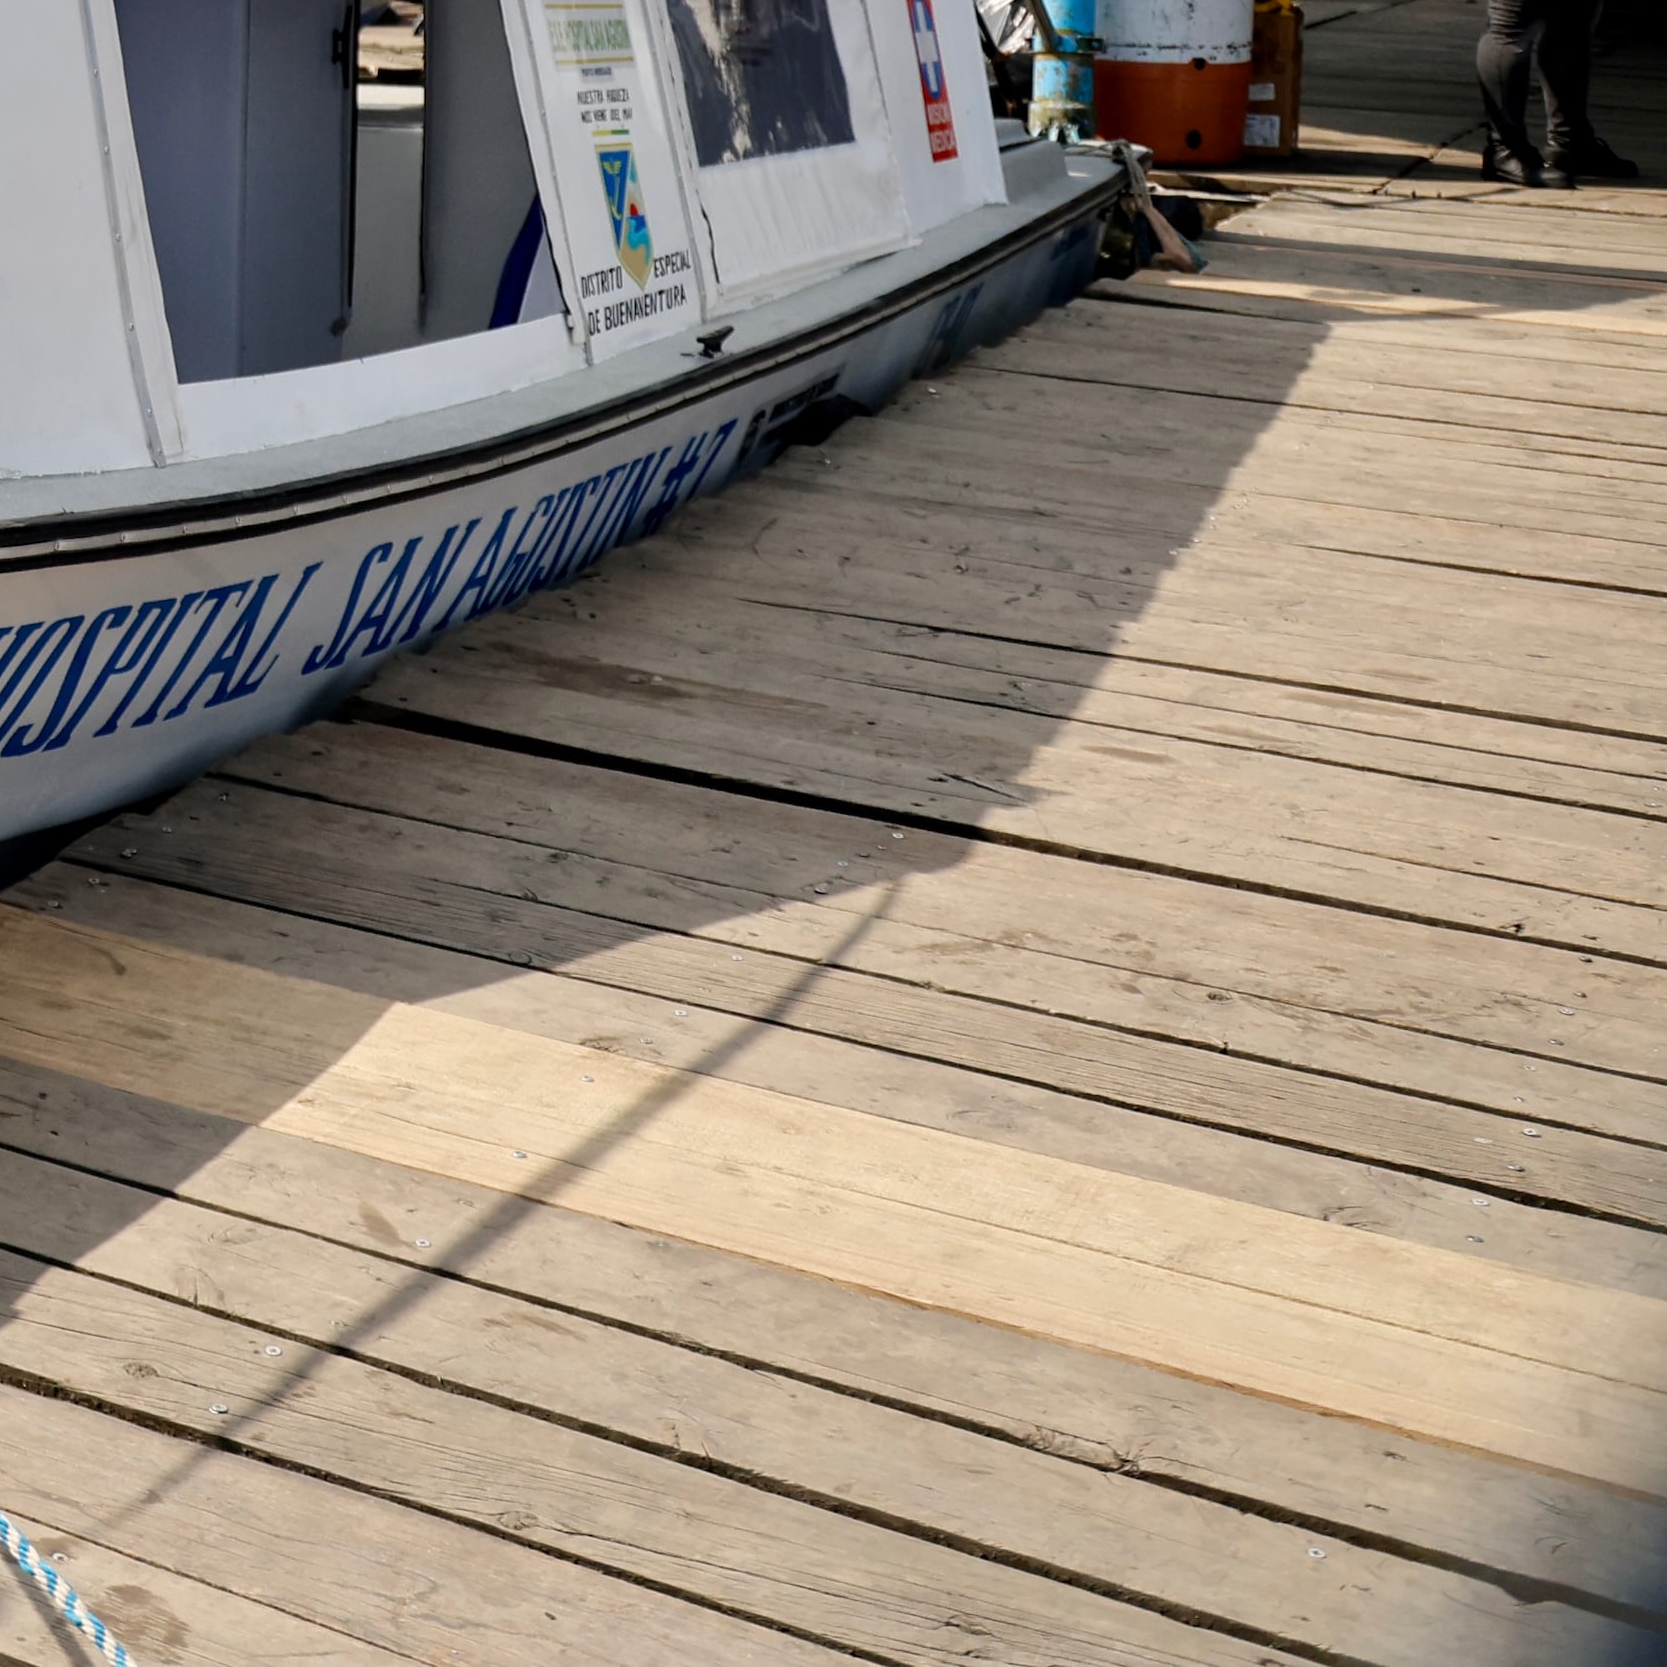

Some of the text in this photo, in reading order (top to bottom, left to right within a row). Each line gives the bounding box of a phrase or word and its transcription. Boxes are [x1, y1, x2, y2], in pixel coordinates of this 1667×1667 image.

[581, 249, 691, 300] DISTRITO ESPECIAL
[587, 283, 688, 336] DE BUENAVENTURA
[302, 518, 482, 676] SAN
[433, 446, 674, 631] AGUSTIN
